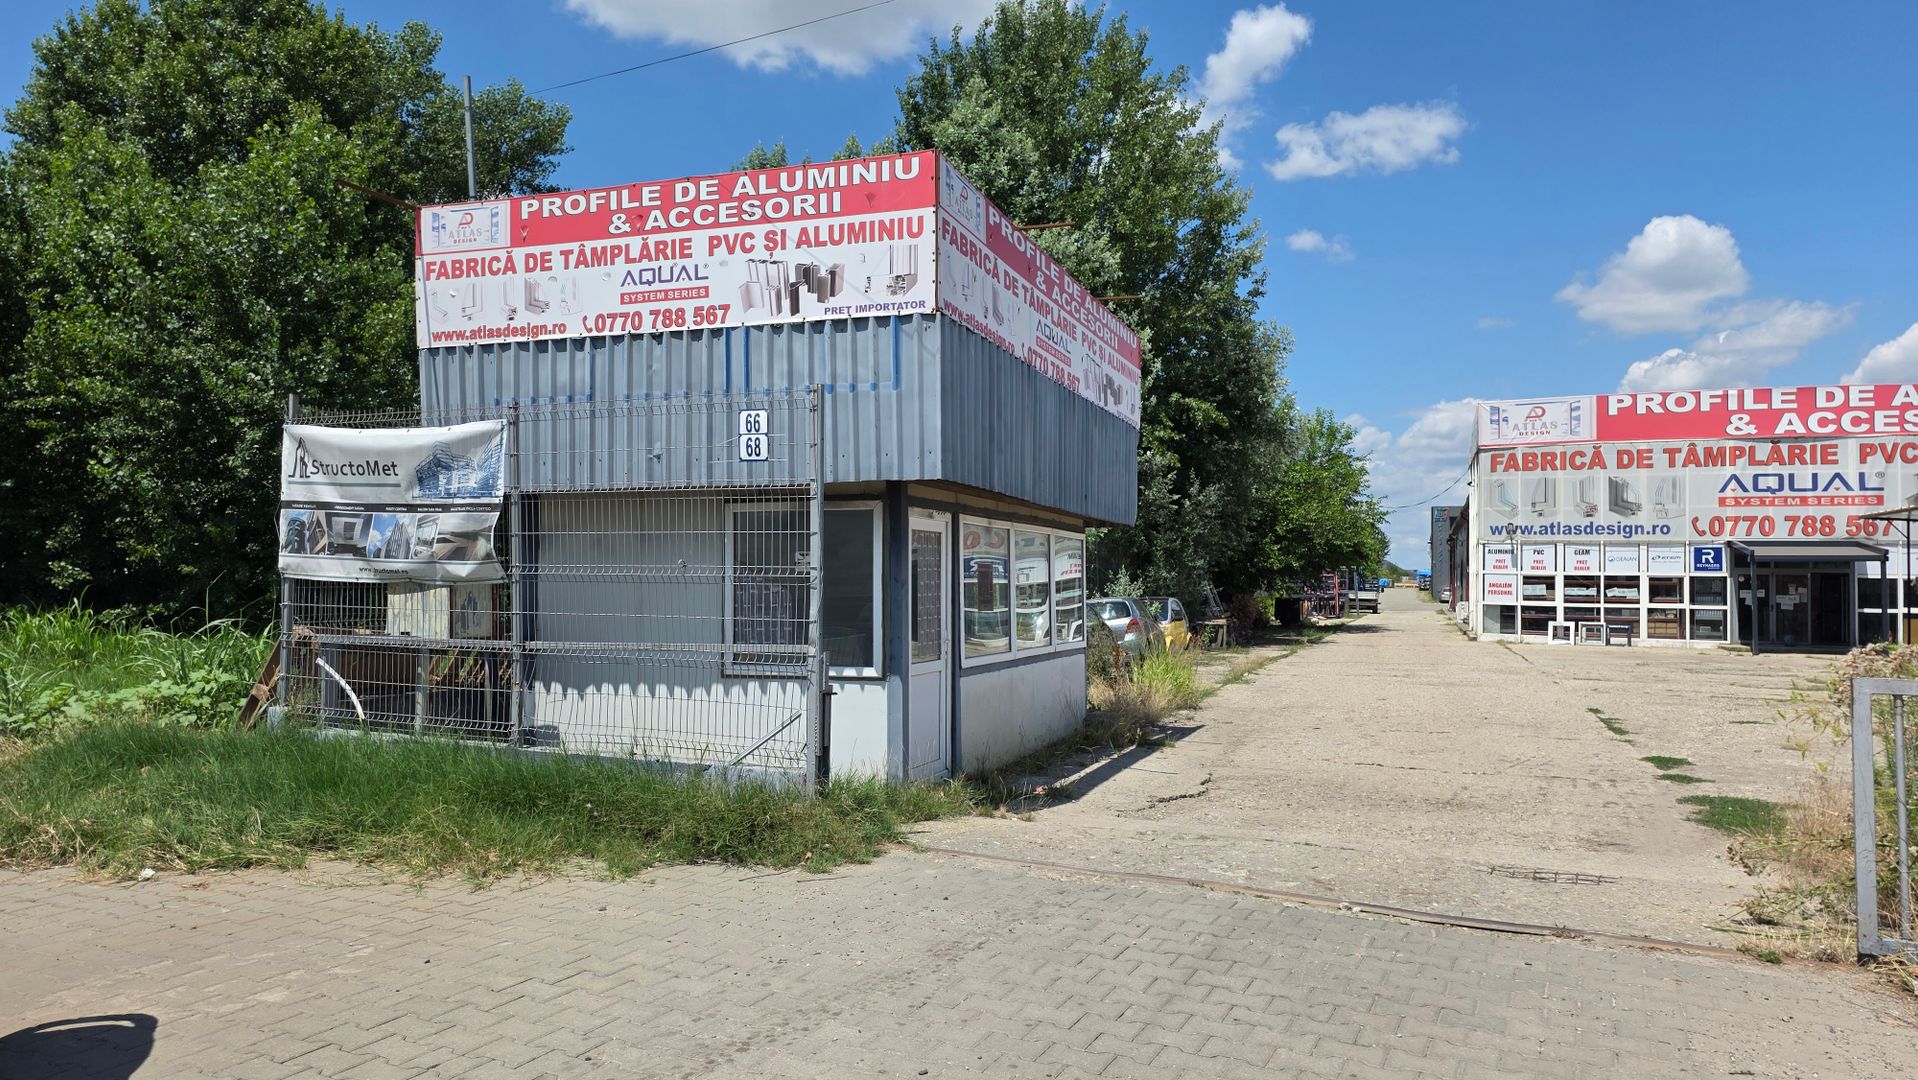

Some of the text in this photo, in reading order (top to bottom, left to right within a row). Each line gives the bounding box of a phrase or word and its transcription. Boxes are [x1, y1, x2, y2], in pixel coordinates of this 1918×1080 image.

[521, 157, 920, 220] PROFILE DE ALUMINIU
[608, 191, 841, 234] & ACCESORII
[448, 227, 482, 239] ATLAS
[425, 215, 924, 281] FABRICĂ DE TÂMPLĂRIE PVC ȘI ALUMINIU
[942, 216, 1000, 284] FABRICĂ
[1003, 269, 1019, 297] DE
[1081, 330, 1096, 356] PVC
[989, 205, 1137, 348] PROFILE DE ALUMINIU
[623, 287, 706, 304] SYSTEM SERIES
[855, 300, 926, 313] IMPORTATOR
[594, 304, 731, 333] 0770 788 567
[1036, 271, 1118, 349] & ACCESORII
[432, 321, 567, 342] www.atlasdesign.ro
[1027, 346, 1080, 393] 0770 788 567
[1607, 388, 1798, 416] PROFILE
[1815, 385, 1875, 408] DE
[745, 413, 760, 433] 66
[1512, 421, 1558, 432] ATLAS
[1725, 413, 1758, 435] &
[745, 437, 761, 457] 68
[1490, 440, 1918, 472] FABRICĂ DE TÂMPLĂRIE PVC
[310, 458, 398, 477] StructoMet
[1725, 496, 1878, 506] SYSTEM SERIES
[1490, 521, 1671, 538] www.atlasdesign.ro
[1708, 515, 1776, 537] 0770
[1784, 514, 1836, 537] 788
